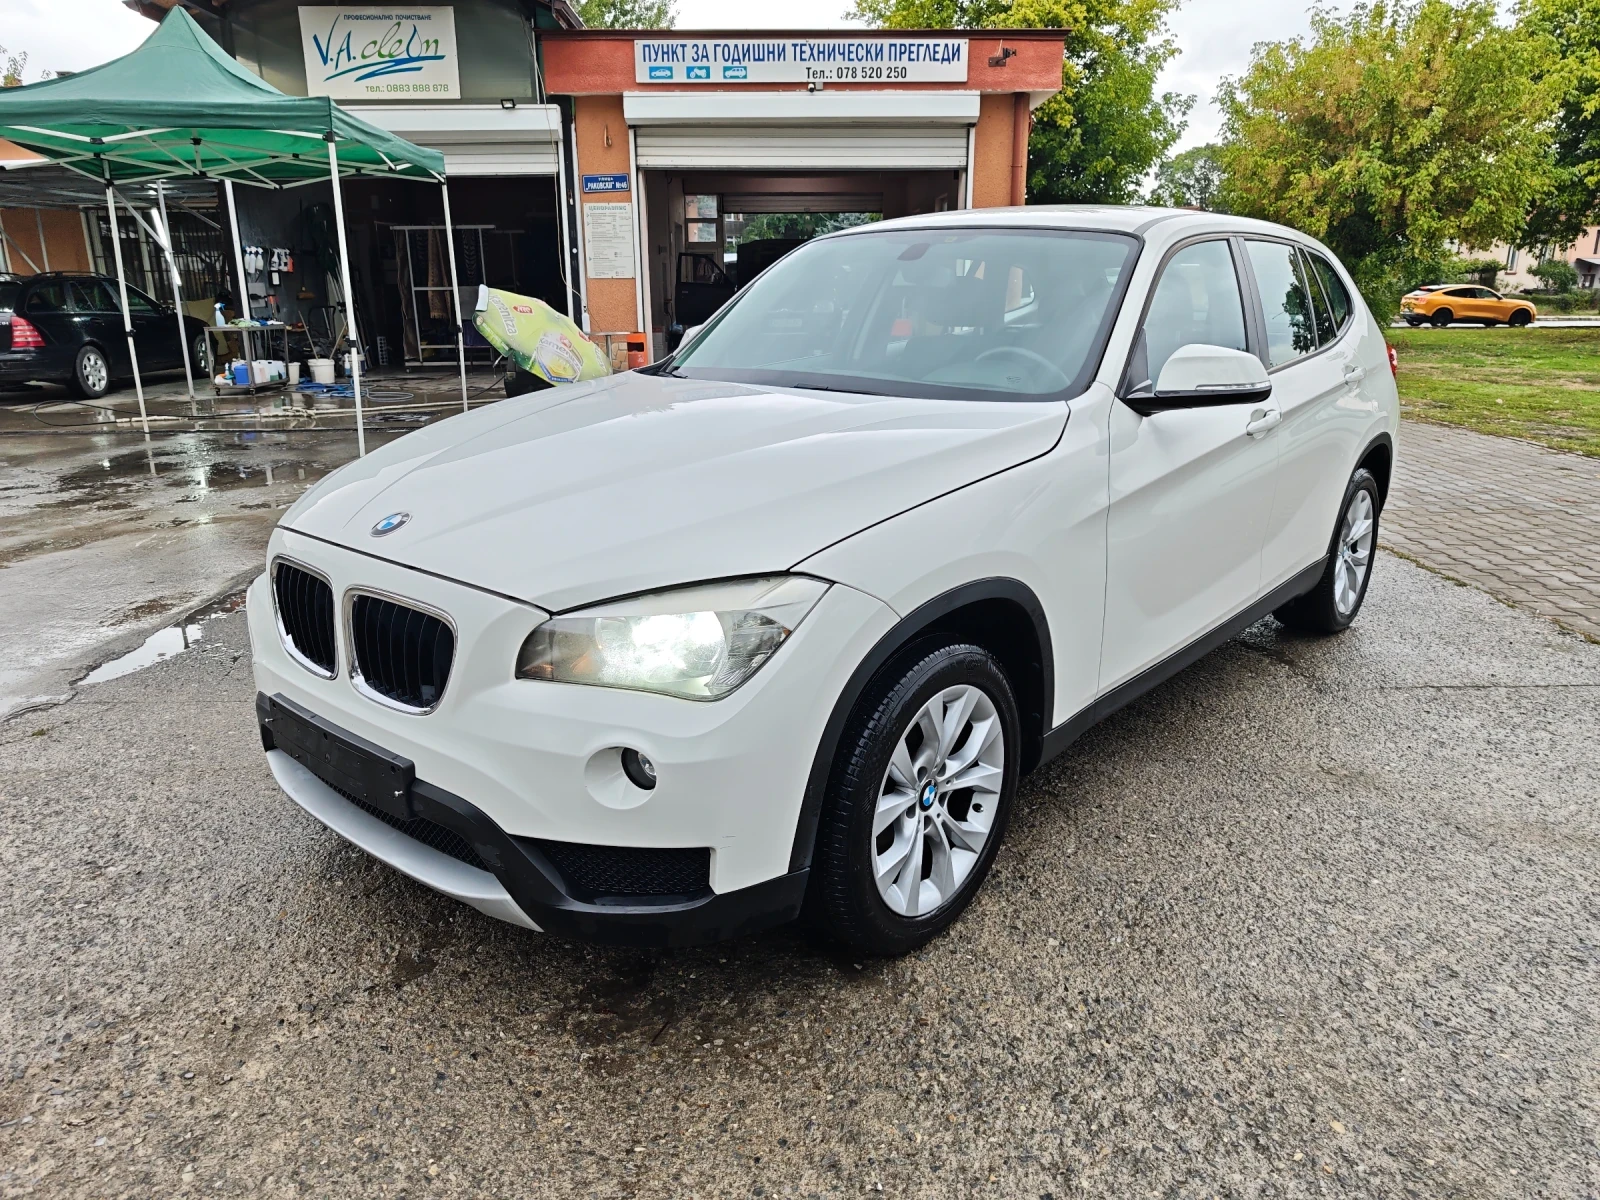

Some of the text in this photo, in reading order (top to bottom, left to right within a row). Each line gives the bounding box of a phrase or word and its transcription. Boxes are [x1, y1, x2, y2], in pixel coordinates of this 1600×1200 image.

[642, 43, 961, 65] ПУНКТ ЗА ГОДИШНИ ТЕХНИЧЕСКИ ПРЕГЛЕДИ
[805, 66, 907, 80] Тел.: 078 520 250
[365, 83, 449, 93] тел.: 0883 888 878
